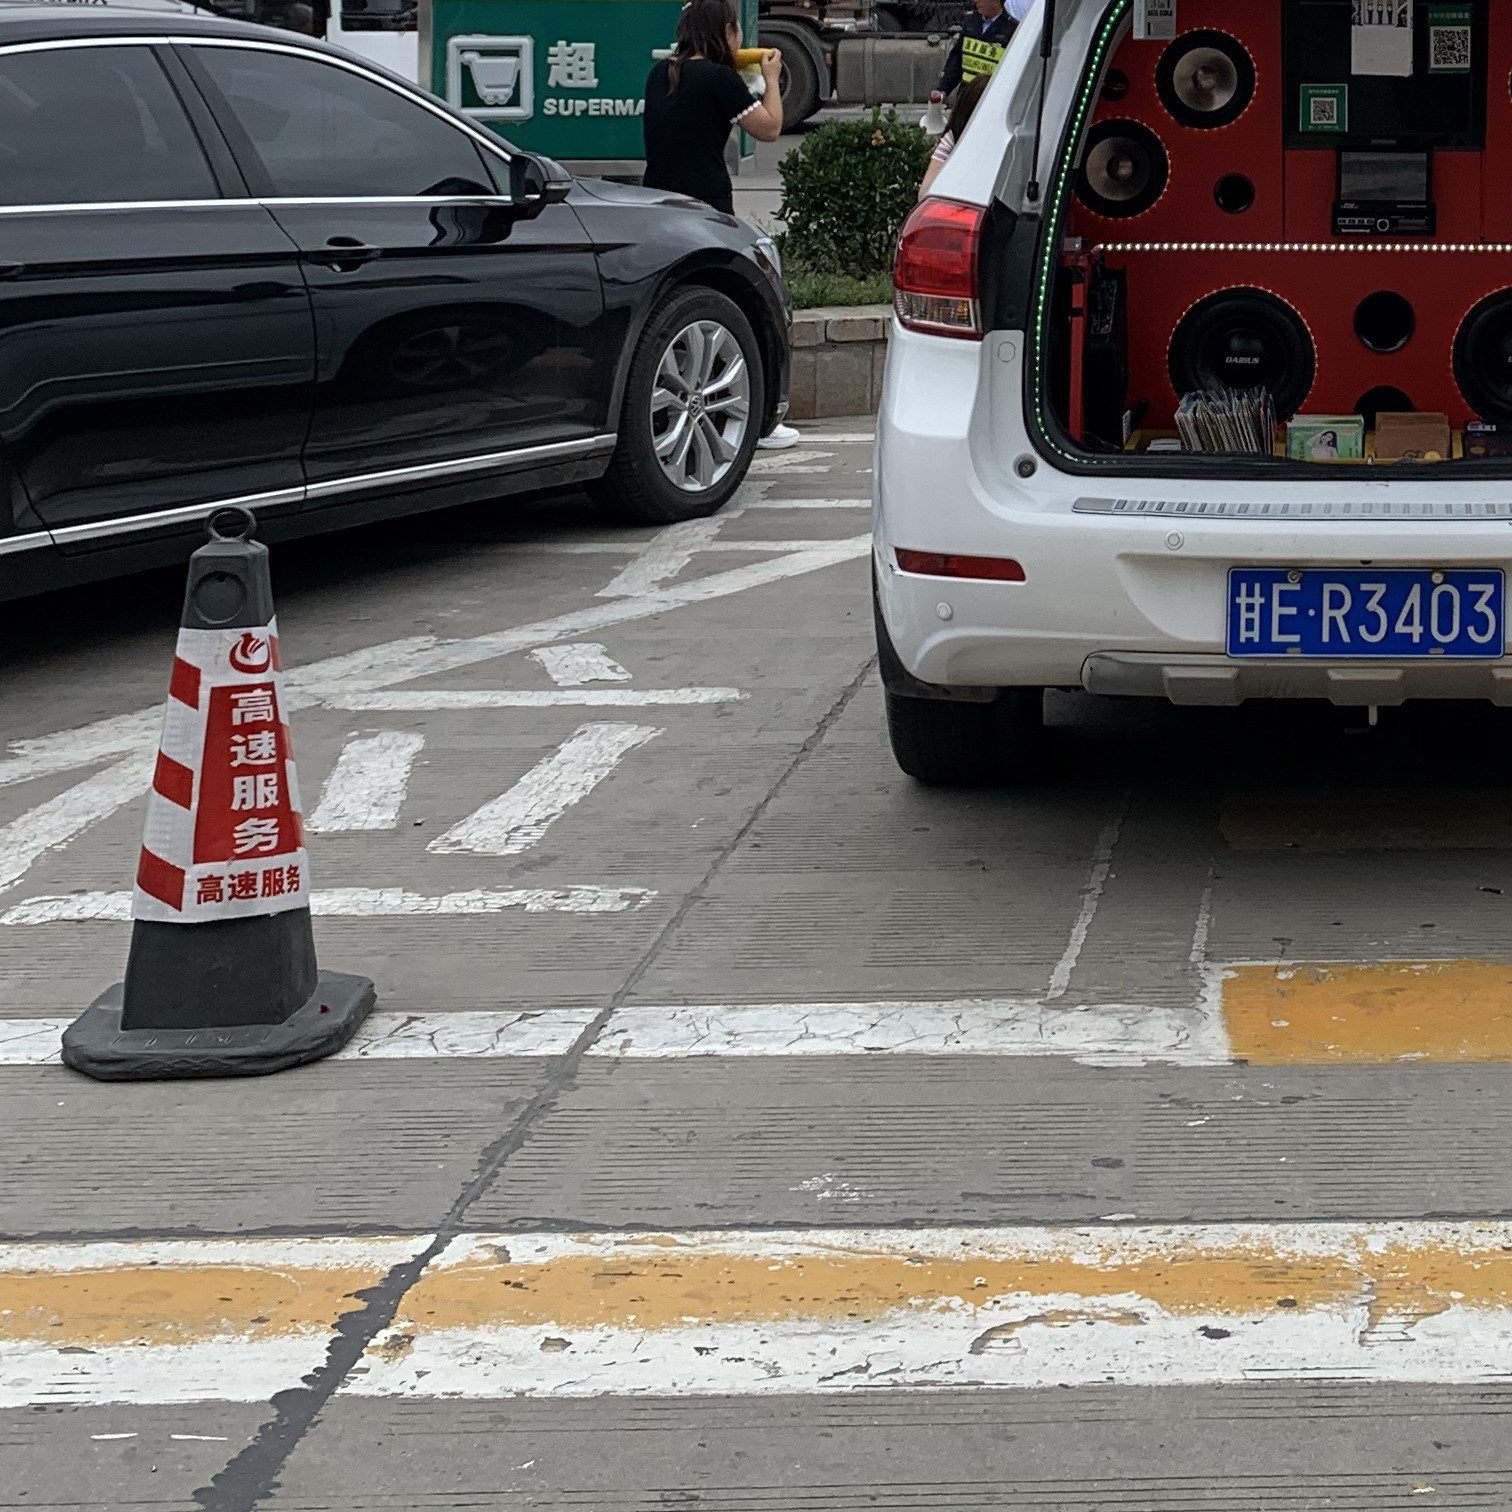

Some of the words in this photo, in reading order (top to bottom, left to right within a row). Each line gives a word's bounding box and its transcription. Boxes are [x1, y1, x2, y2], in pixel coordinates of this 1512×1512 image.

[229, 689, 280, 856] 高速服务
[195, 863, 301, 905] 高速服务
